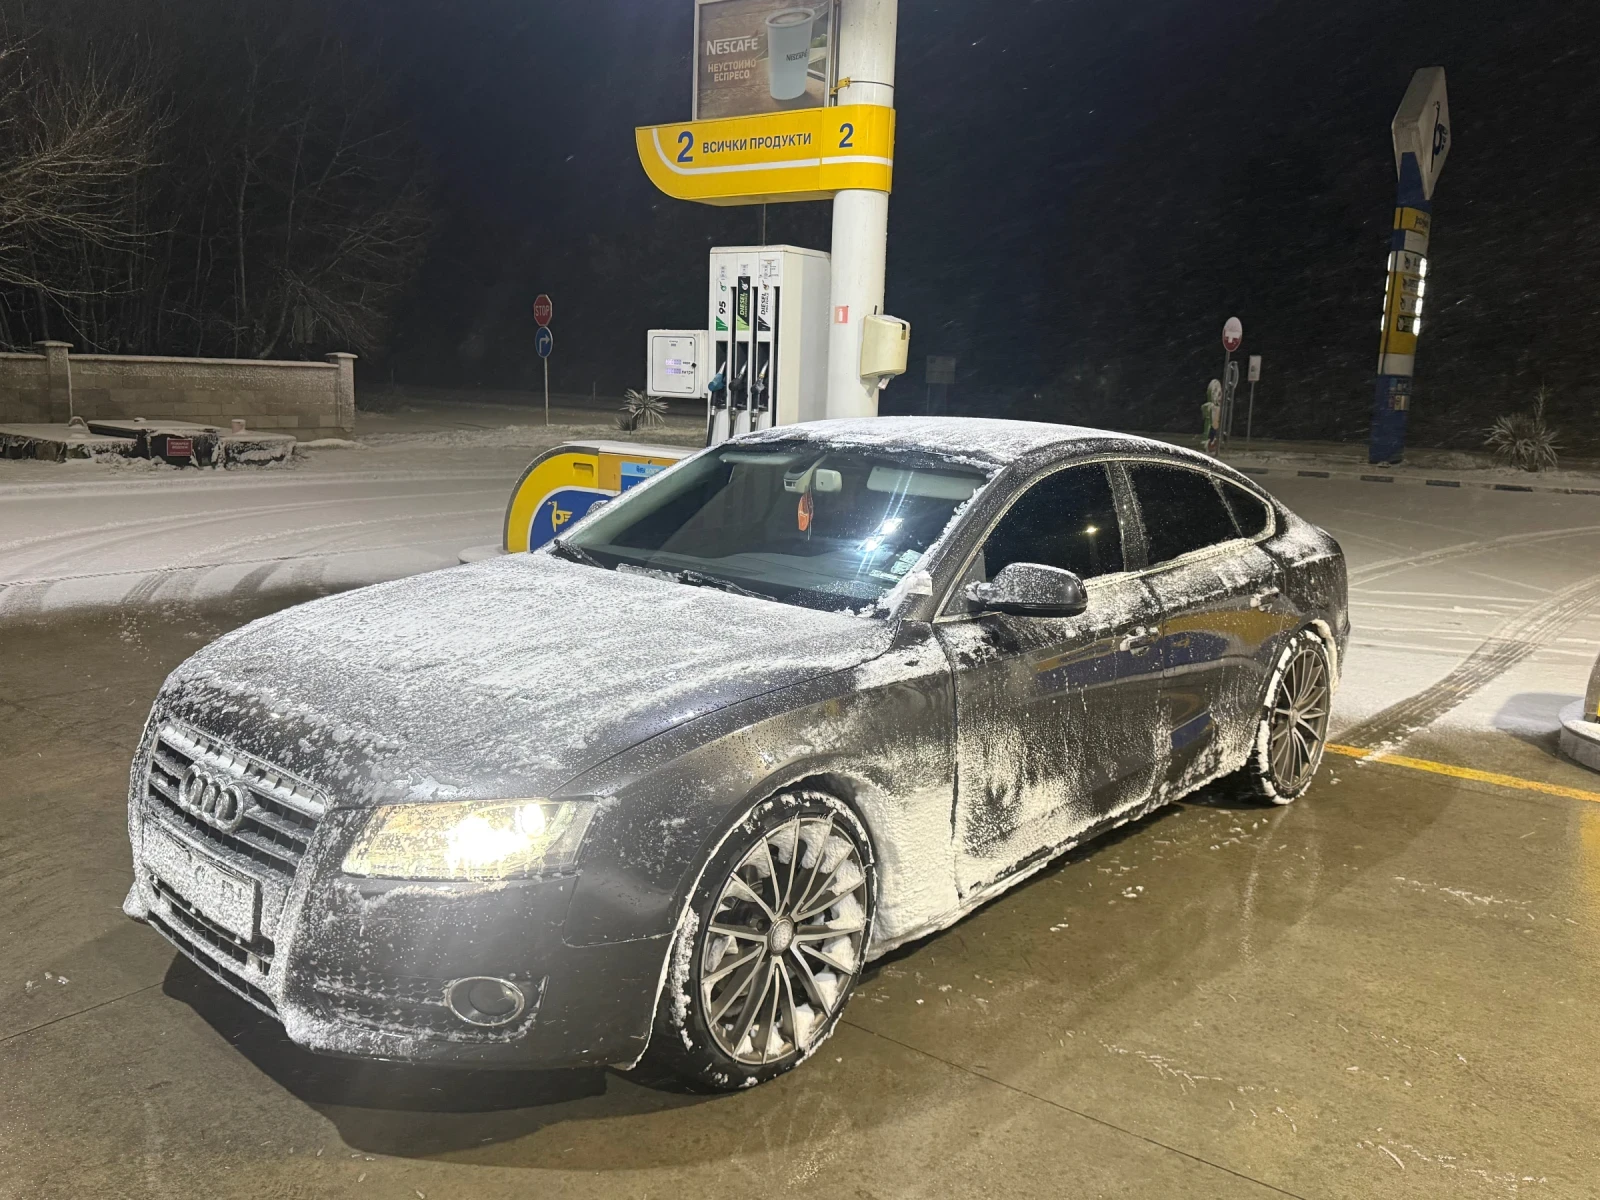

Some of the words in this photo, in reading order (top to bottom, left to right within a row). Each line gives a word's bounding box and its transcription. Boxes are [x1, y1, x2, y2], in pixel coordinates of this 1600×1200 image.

[708, 60, 757, 73] НЕУСТОИМО
[714, 70, 750, 82] ЕСПРЕСО
[839, 123, 854, 148] 2
[677, 131, 694, 162] 2
[703, 135, 747, 154] ВСИЧКИ
[749, 133, 811, 151] ПРОДУКТИ
[535, 305, 550, 316] STOP
[719, 301, 726, 314] 95
